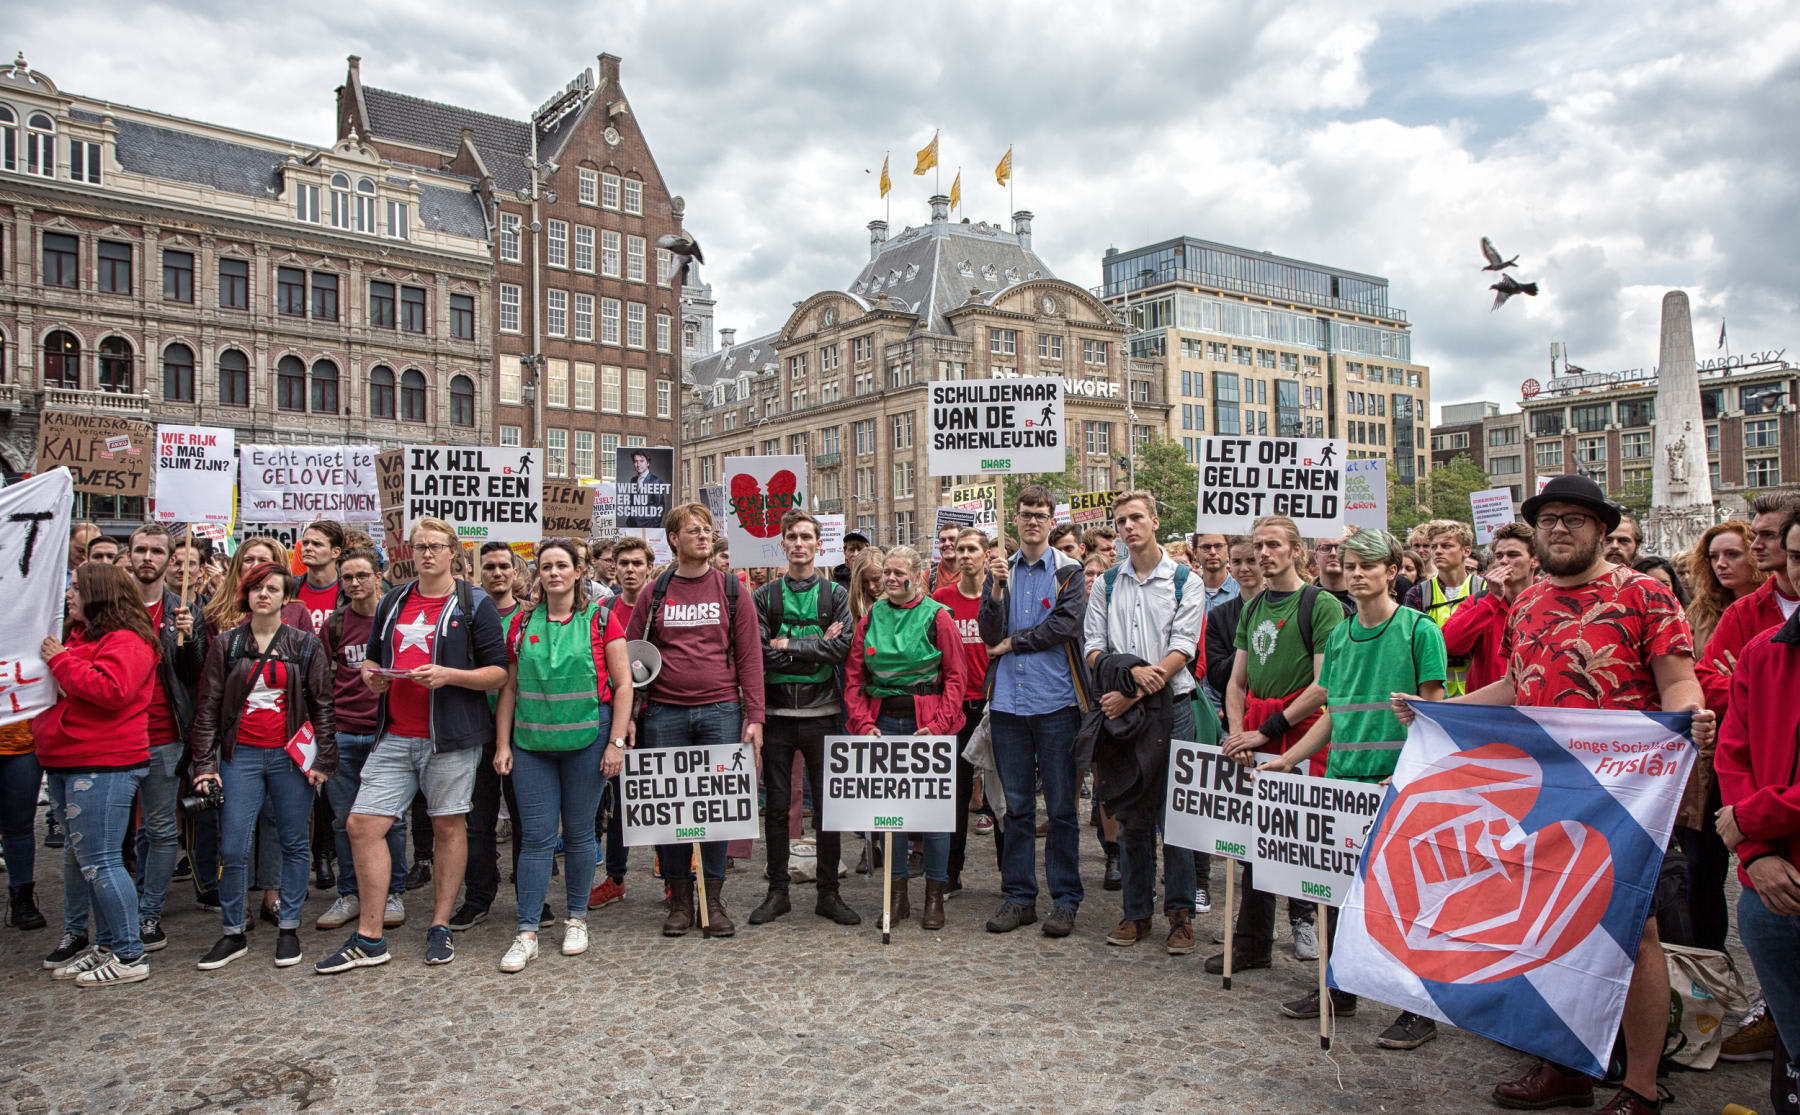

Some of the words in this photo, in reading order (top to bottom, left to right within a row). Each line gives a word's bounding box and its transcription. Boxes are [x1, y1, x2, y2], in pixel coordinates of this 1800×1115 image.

[1599, 368, 1648, 386] HOTEL
[934, 384, 1057, 404] SCHULDENAAR
[934, 408, 978, 430] VAN
[986, 406, 1015, 428] DE
[42, 436, 103, 462] KALF
[161, 432, 185, 445] WIE
[188, 434, 217, 447] RIJK
[934, 430, 1057, 450] SAMENLEVING
[160, 445, 173, 457] IS
[177, 446, 205, 458] MAG
[253, 452, 298, 467] Echt
[305, 452, 344, 467] niet
[352, 452, 372, 467] te
[411, 449, 439, 471] IK
[447, 450, 490, 472] WIL
[1206, 440, 1250, 464] LET
[1258, 440, 1297, 465] OP!
[160, 457, 191, 470] SLIM
[195, 459, 230, 472] ZIJN?
[981, 459, 1011, 469] DWARS
[45, 464, 142, 489] EWEEST
[262, 468, 362, 488] GELOVEN,
[383, 473, 404, 489] KO
[411, 474, 480, 497] LATER
[488, 475, 529, 498] EEN
[1204, 466, 1259, 489] GELD
[1267, 469, 1338, 491] LENEN
[617, 483, 637, 494] WIE
[641, 483, 671, 495] HEEFT
[253, 500, 276, 509] van
[282, 492, 375, 511] ENGELSHOVEN
[617, 494, 630, 506] ER
[633, 495, 648, 506] NU
[728, 491, 802, 515] SCHULDEN
[1202, 491, 1265, 516] KOST
[1274, 494, 1337, 519] GELD
[410, 499, 538, 523] HYPOTHEEK
[617, 506, 663, 518] SCHULD?
[458, 526, 488, 536] DWARS
[664, 602, 720, 621] DWARS
[1568, 738, 1608, 754] Jonge
[625, 752, 666, 776] LET
[674, 750, 710, 774] OP!
[830, 742, 951, 774] STRESS
[1595, 754, 1678, 777] Fryslân
[625, 778, 677, 800] GELD
[685, 774, 750, 797] LENEN
[829, 778, 951, 799] GENERATIE
[1258, 779, 1380, 817] SCHULDENAAR
[627, 802, 685, 827] KOST
[692, 799, 751, 822] GELD
[874, 816, 904, 827] DWARS
[675, 827, 706, 838] DWARS
[1258, 805, 1299, 840] VAN
[1306, 813, 1336, 846] DE
[1215, 839, 1246, 856] DWARS
[1301, 881, 1332, 898] DWARS
